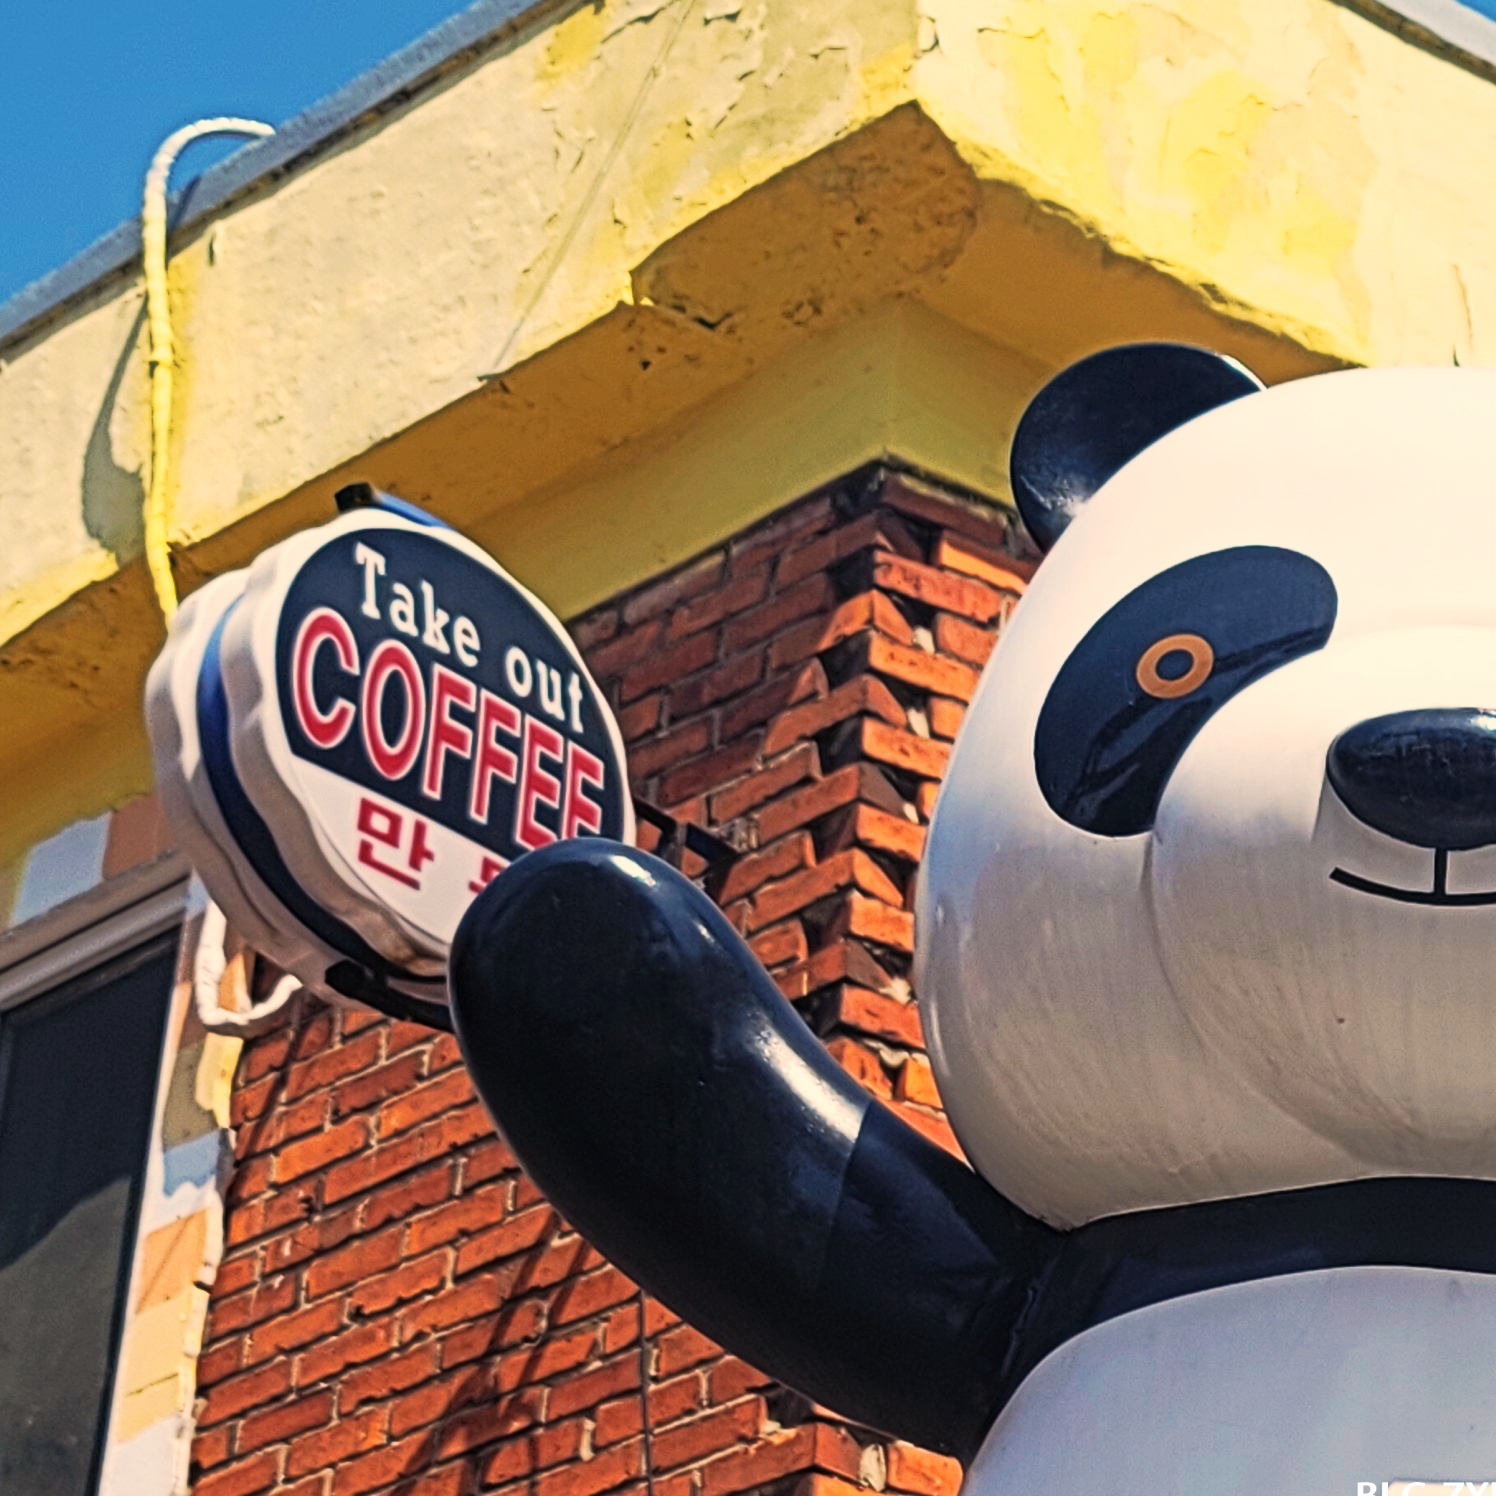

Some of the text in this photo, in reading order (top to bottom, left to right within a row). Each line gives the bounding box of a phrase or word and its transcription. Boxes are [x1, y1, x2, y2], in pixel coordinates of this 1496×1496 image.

[291, 606, 605, 853] COFFEE
[354, 541, 585, 735] Take out
